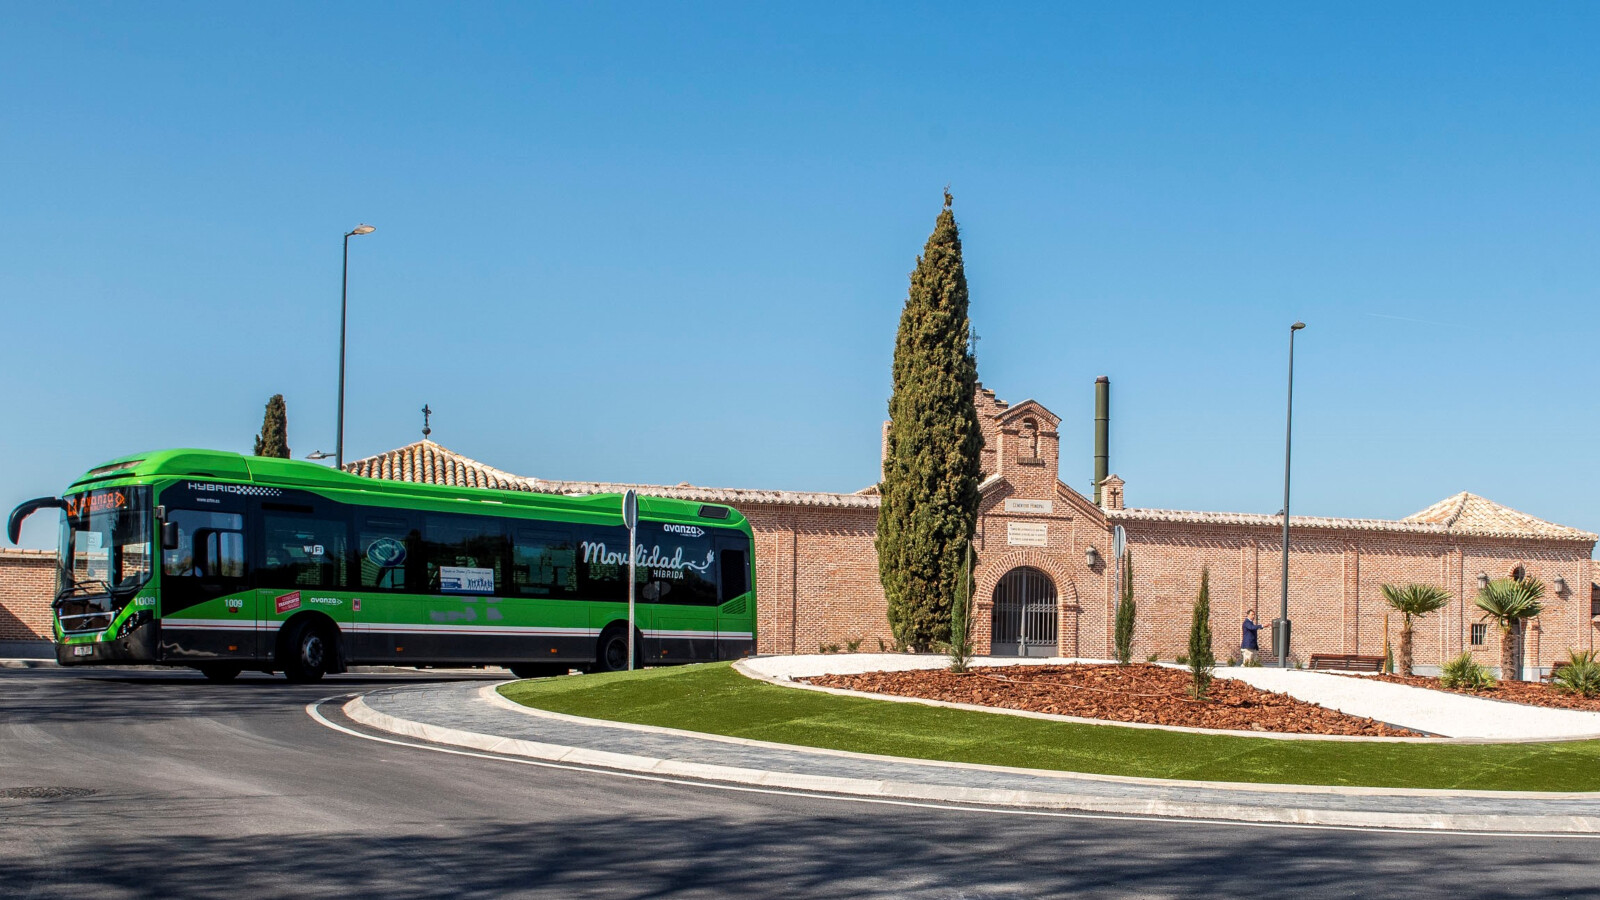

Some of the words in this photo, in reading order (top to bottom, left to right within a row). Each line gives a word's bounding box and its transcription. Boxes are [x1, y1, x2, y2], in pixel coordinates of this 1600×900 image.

[187, 481, 237, 493] HYBRID
[663, 523, 697, 534] avanza
[580, 541, 683, 569] Movlidad
[653, 567, 684, 580] HÍBRIDA
[134, 596, 155, 606] 1009
[224, 598, 243, 608] 1009
